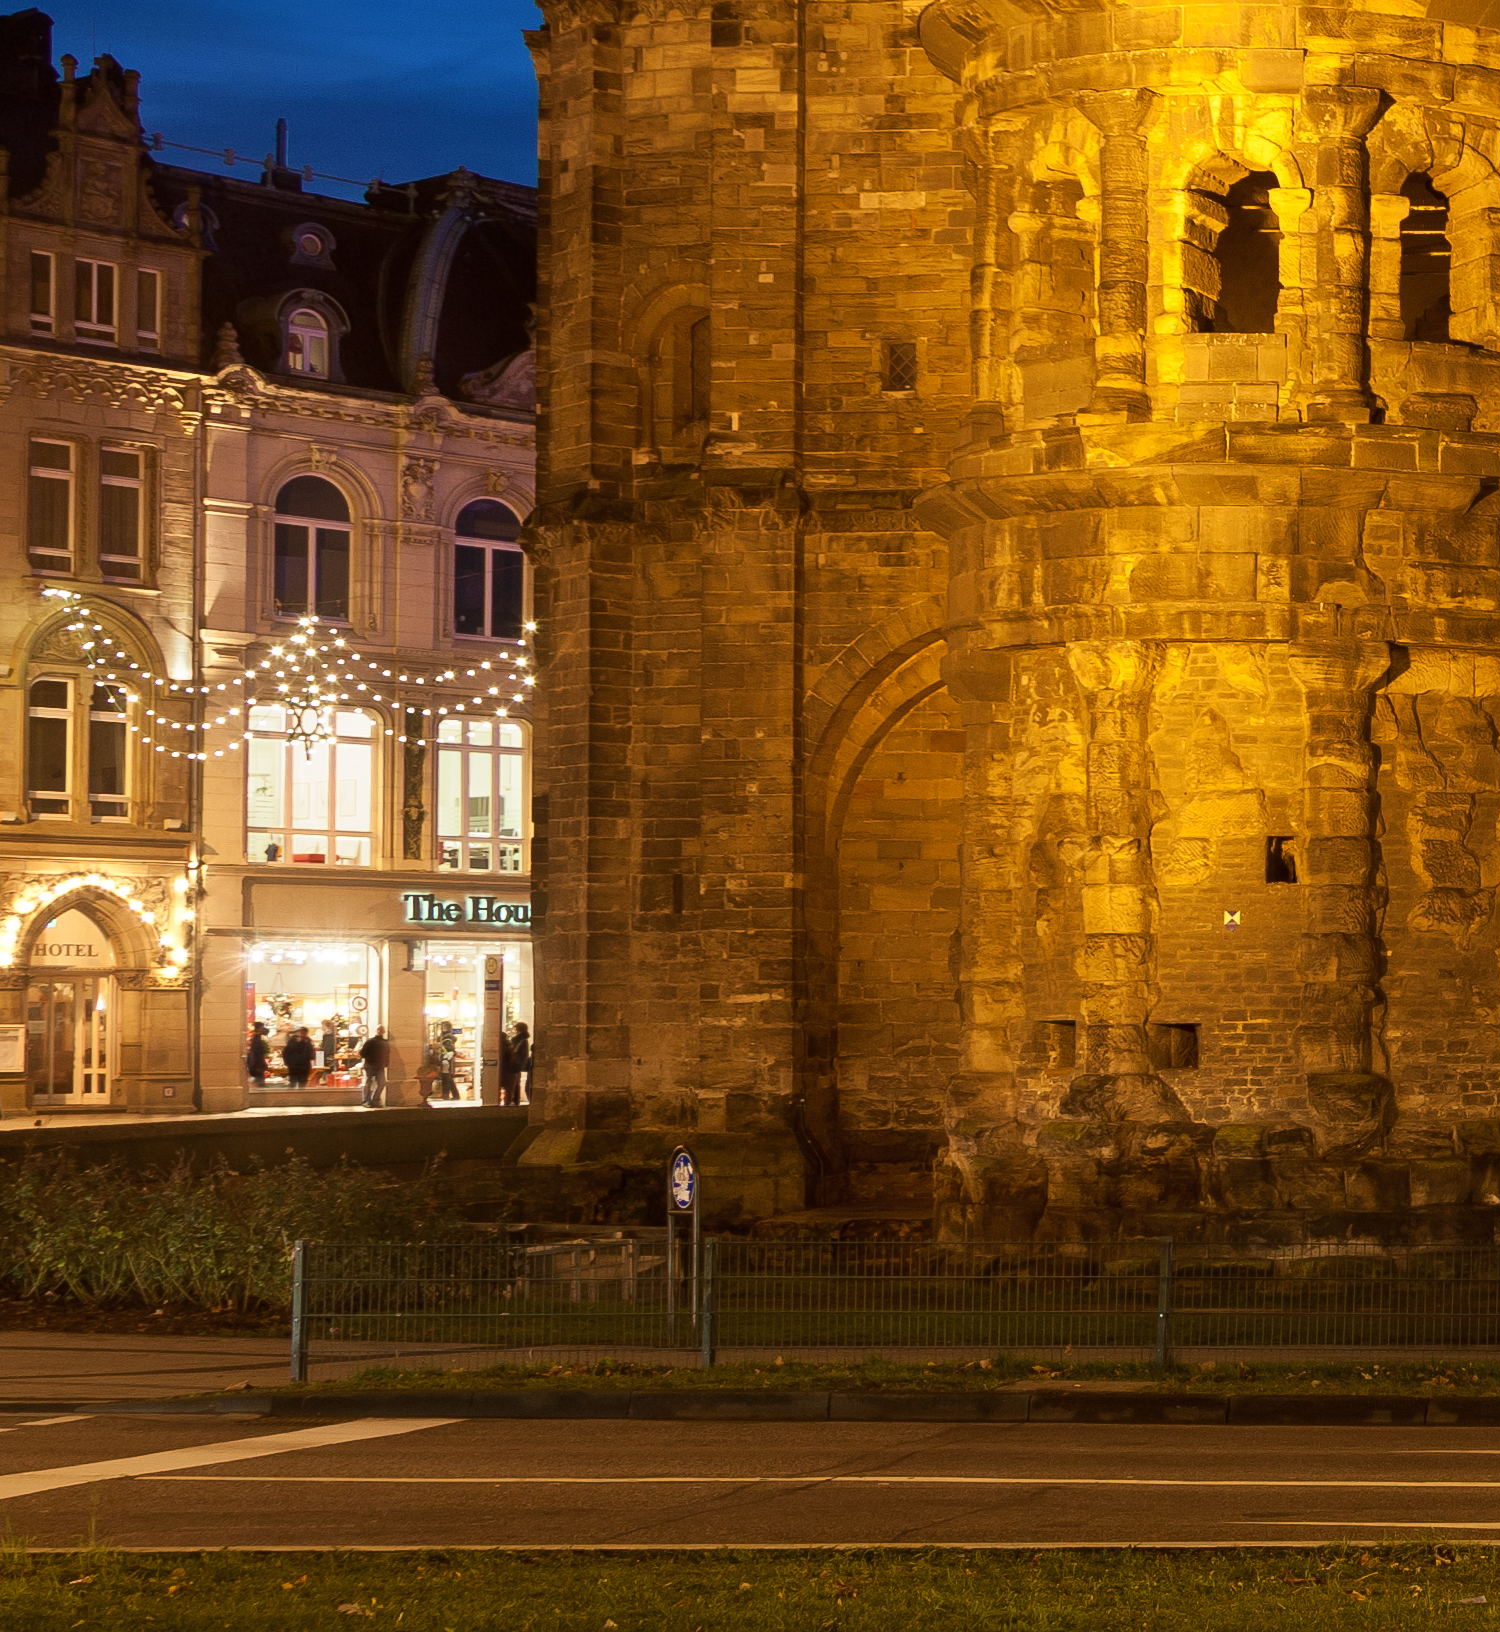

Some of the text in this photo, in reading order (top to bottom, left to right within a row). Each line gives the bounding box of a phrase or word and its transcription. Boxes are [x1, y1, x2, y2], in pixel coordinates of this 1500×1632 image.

[404, 893, 531, 923] The Hou
[34, 944, 99, 957] HOTEL
